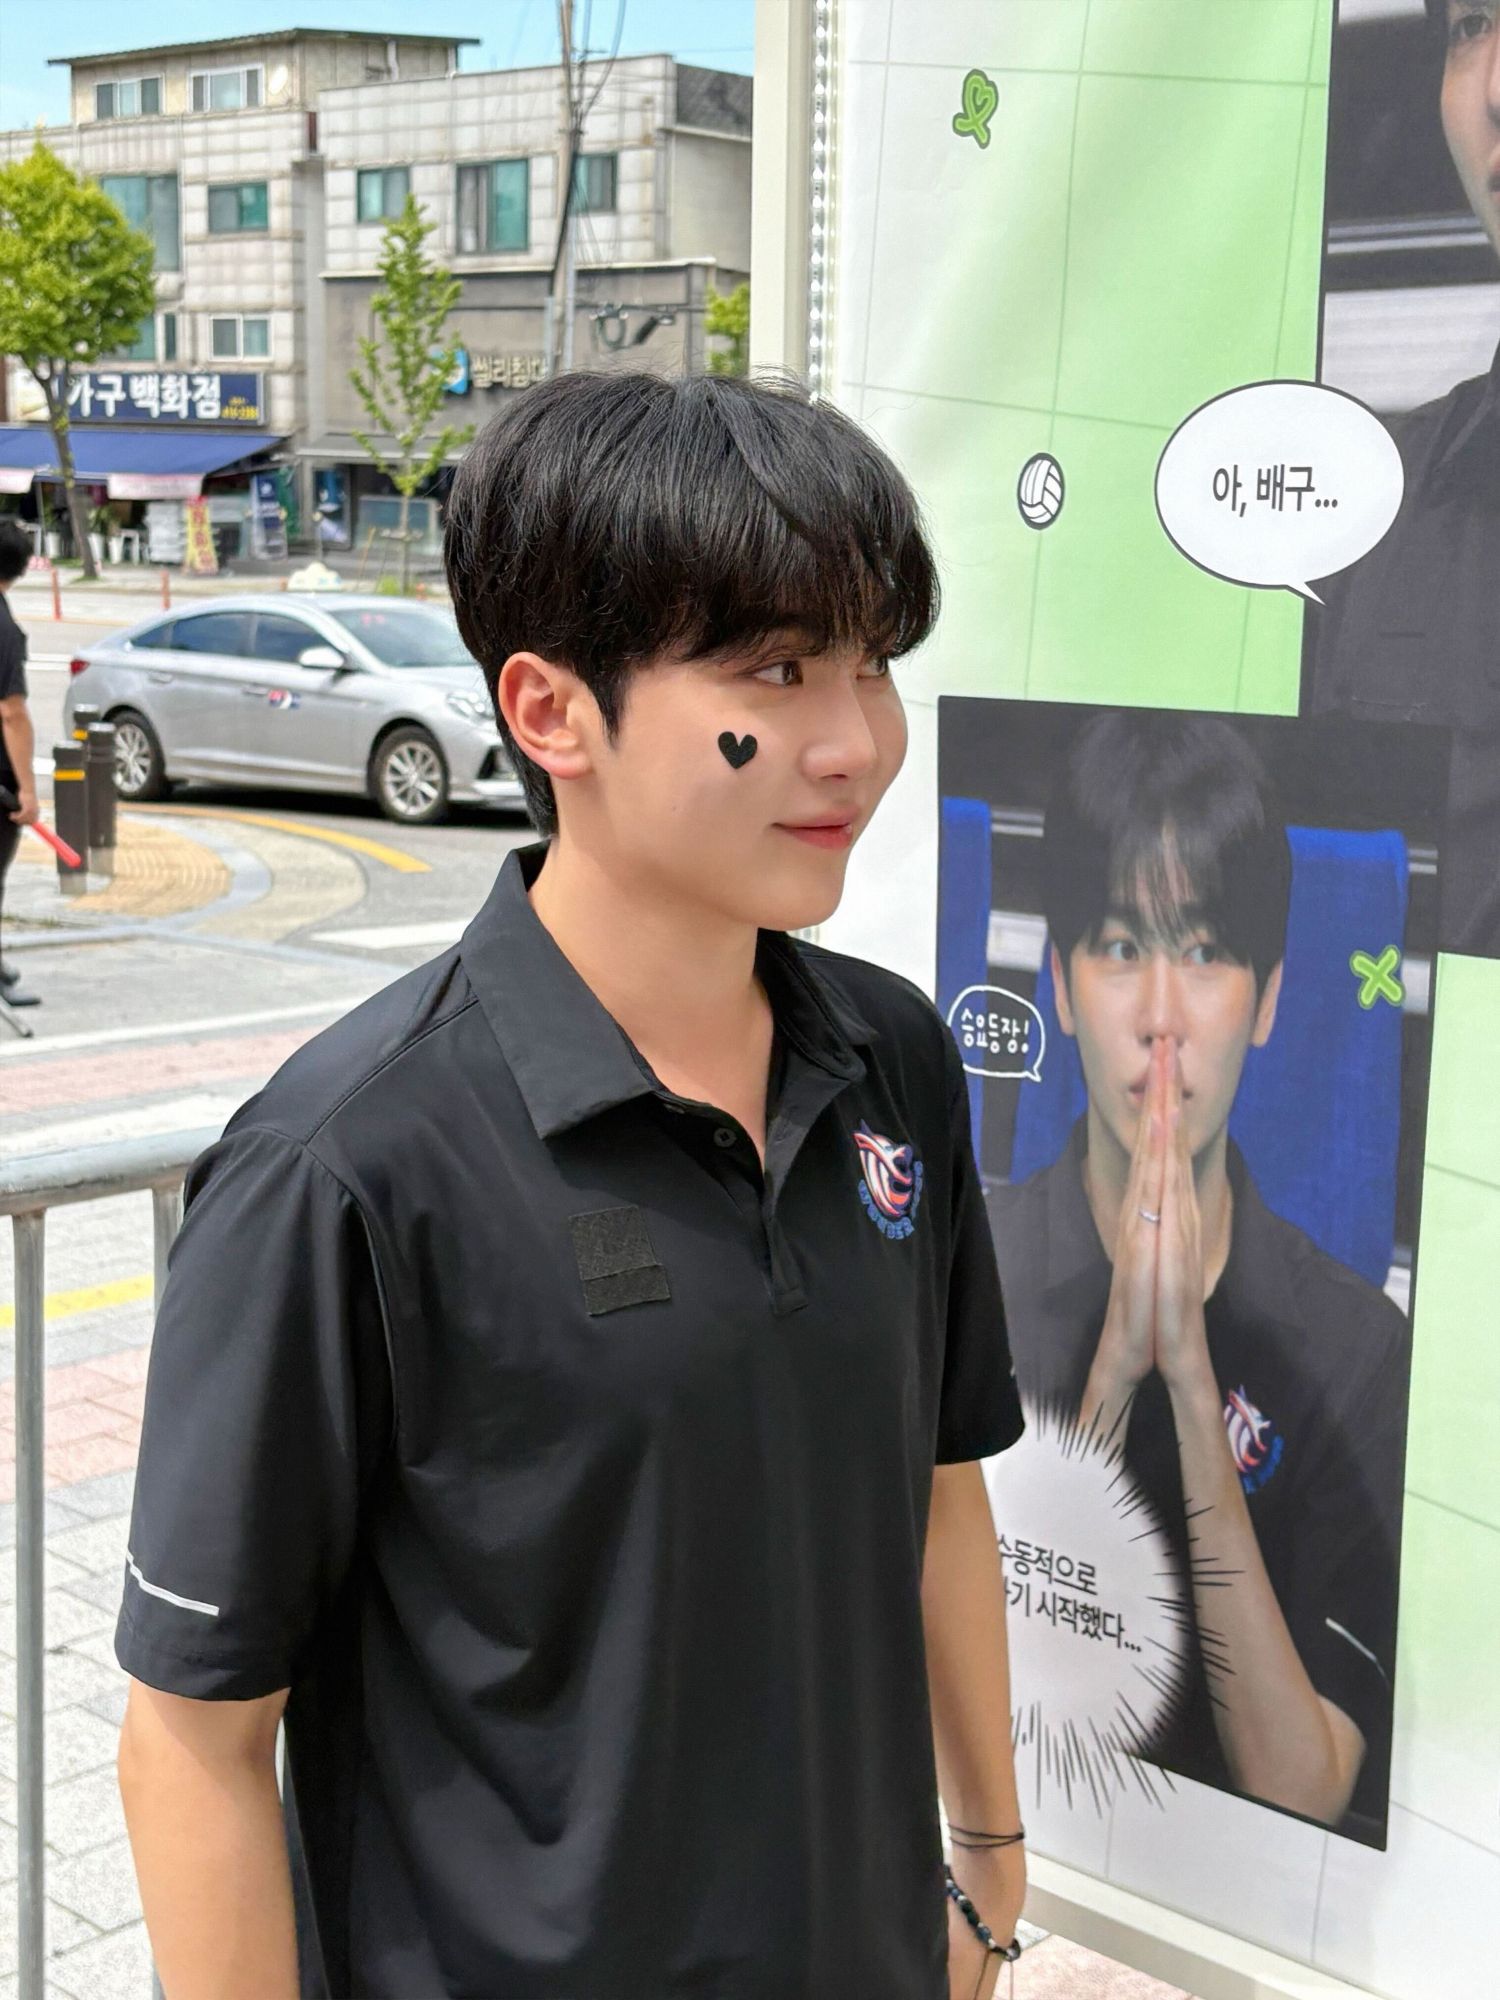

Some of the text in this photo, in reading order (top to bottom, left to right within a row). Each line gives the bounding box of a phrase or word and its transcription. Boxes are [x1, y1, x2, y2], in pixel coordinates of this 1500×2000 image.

[1212, 463, 1339, 518] 아, 배구...
[960, 1008, 1030, 1054] 승요등장!
[1036, 1591, 1143, 1654] 시작했다...
